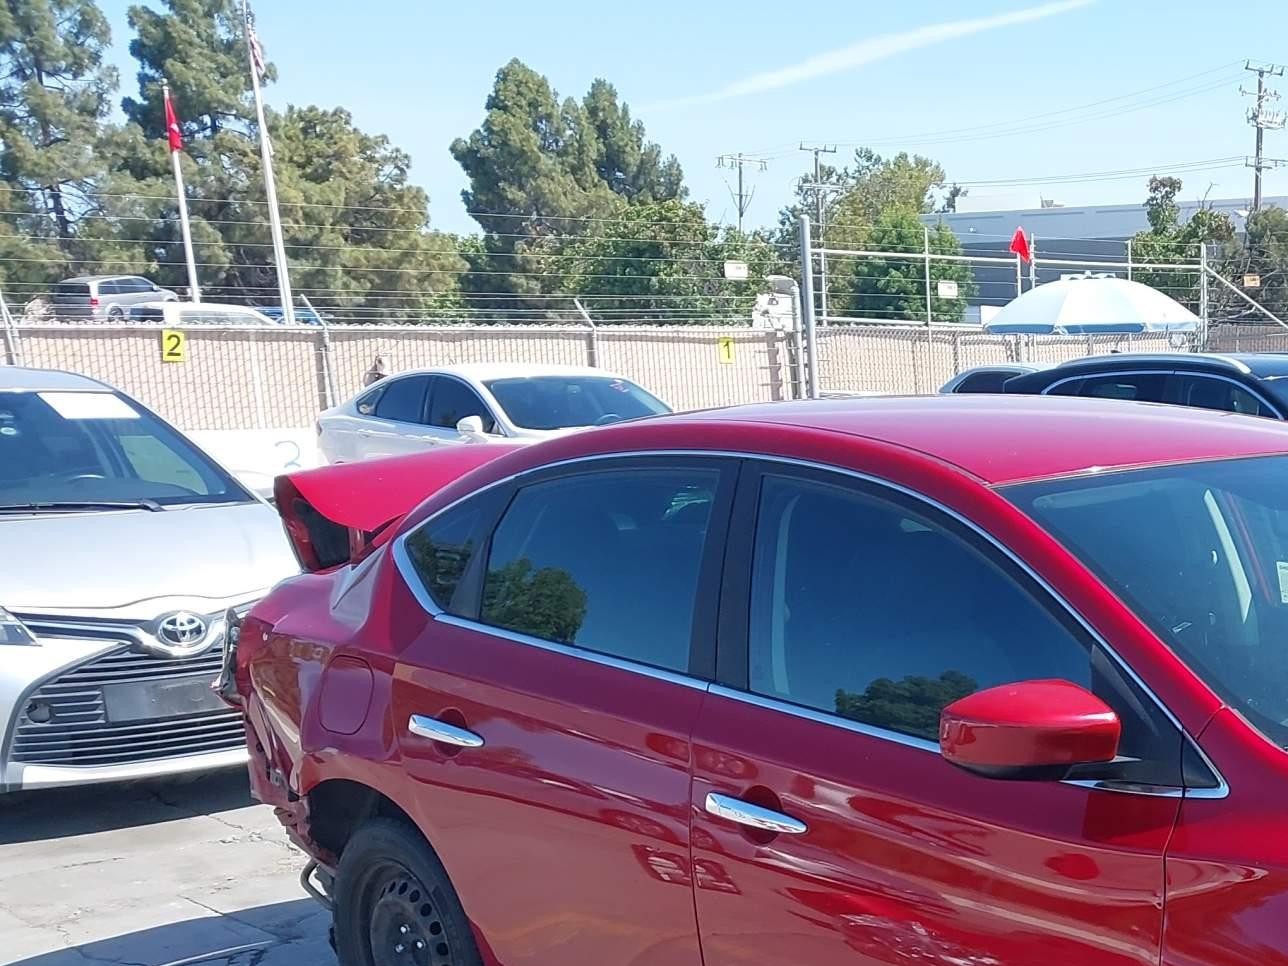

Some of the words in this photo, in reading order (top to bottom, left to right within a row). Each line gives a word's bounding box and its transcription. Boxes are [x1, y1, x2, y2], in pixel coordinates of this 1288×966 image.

[167, 334, 181, 357] 2
[724, 340, 730, 359] 1
[275, 440, 302, 468] 2
